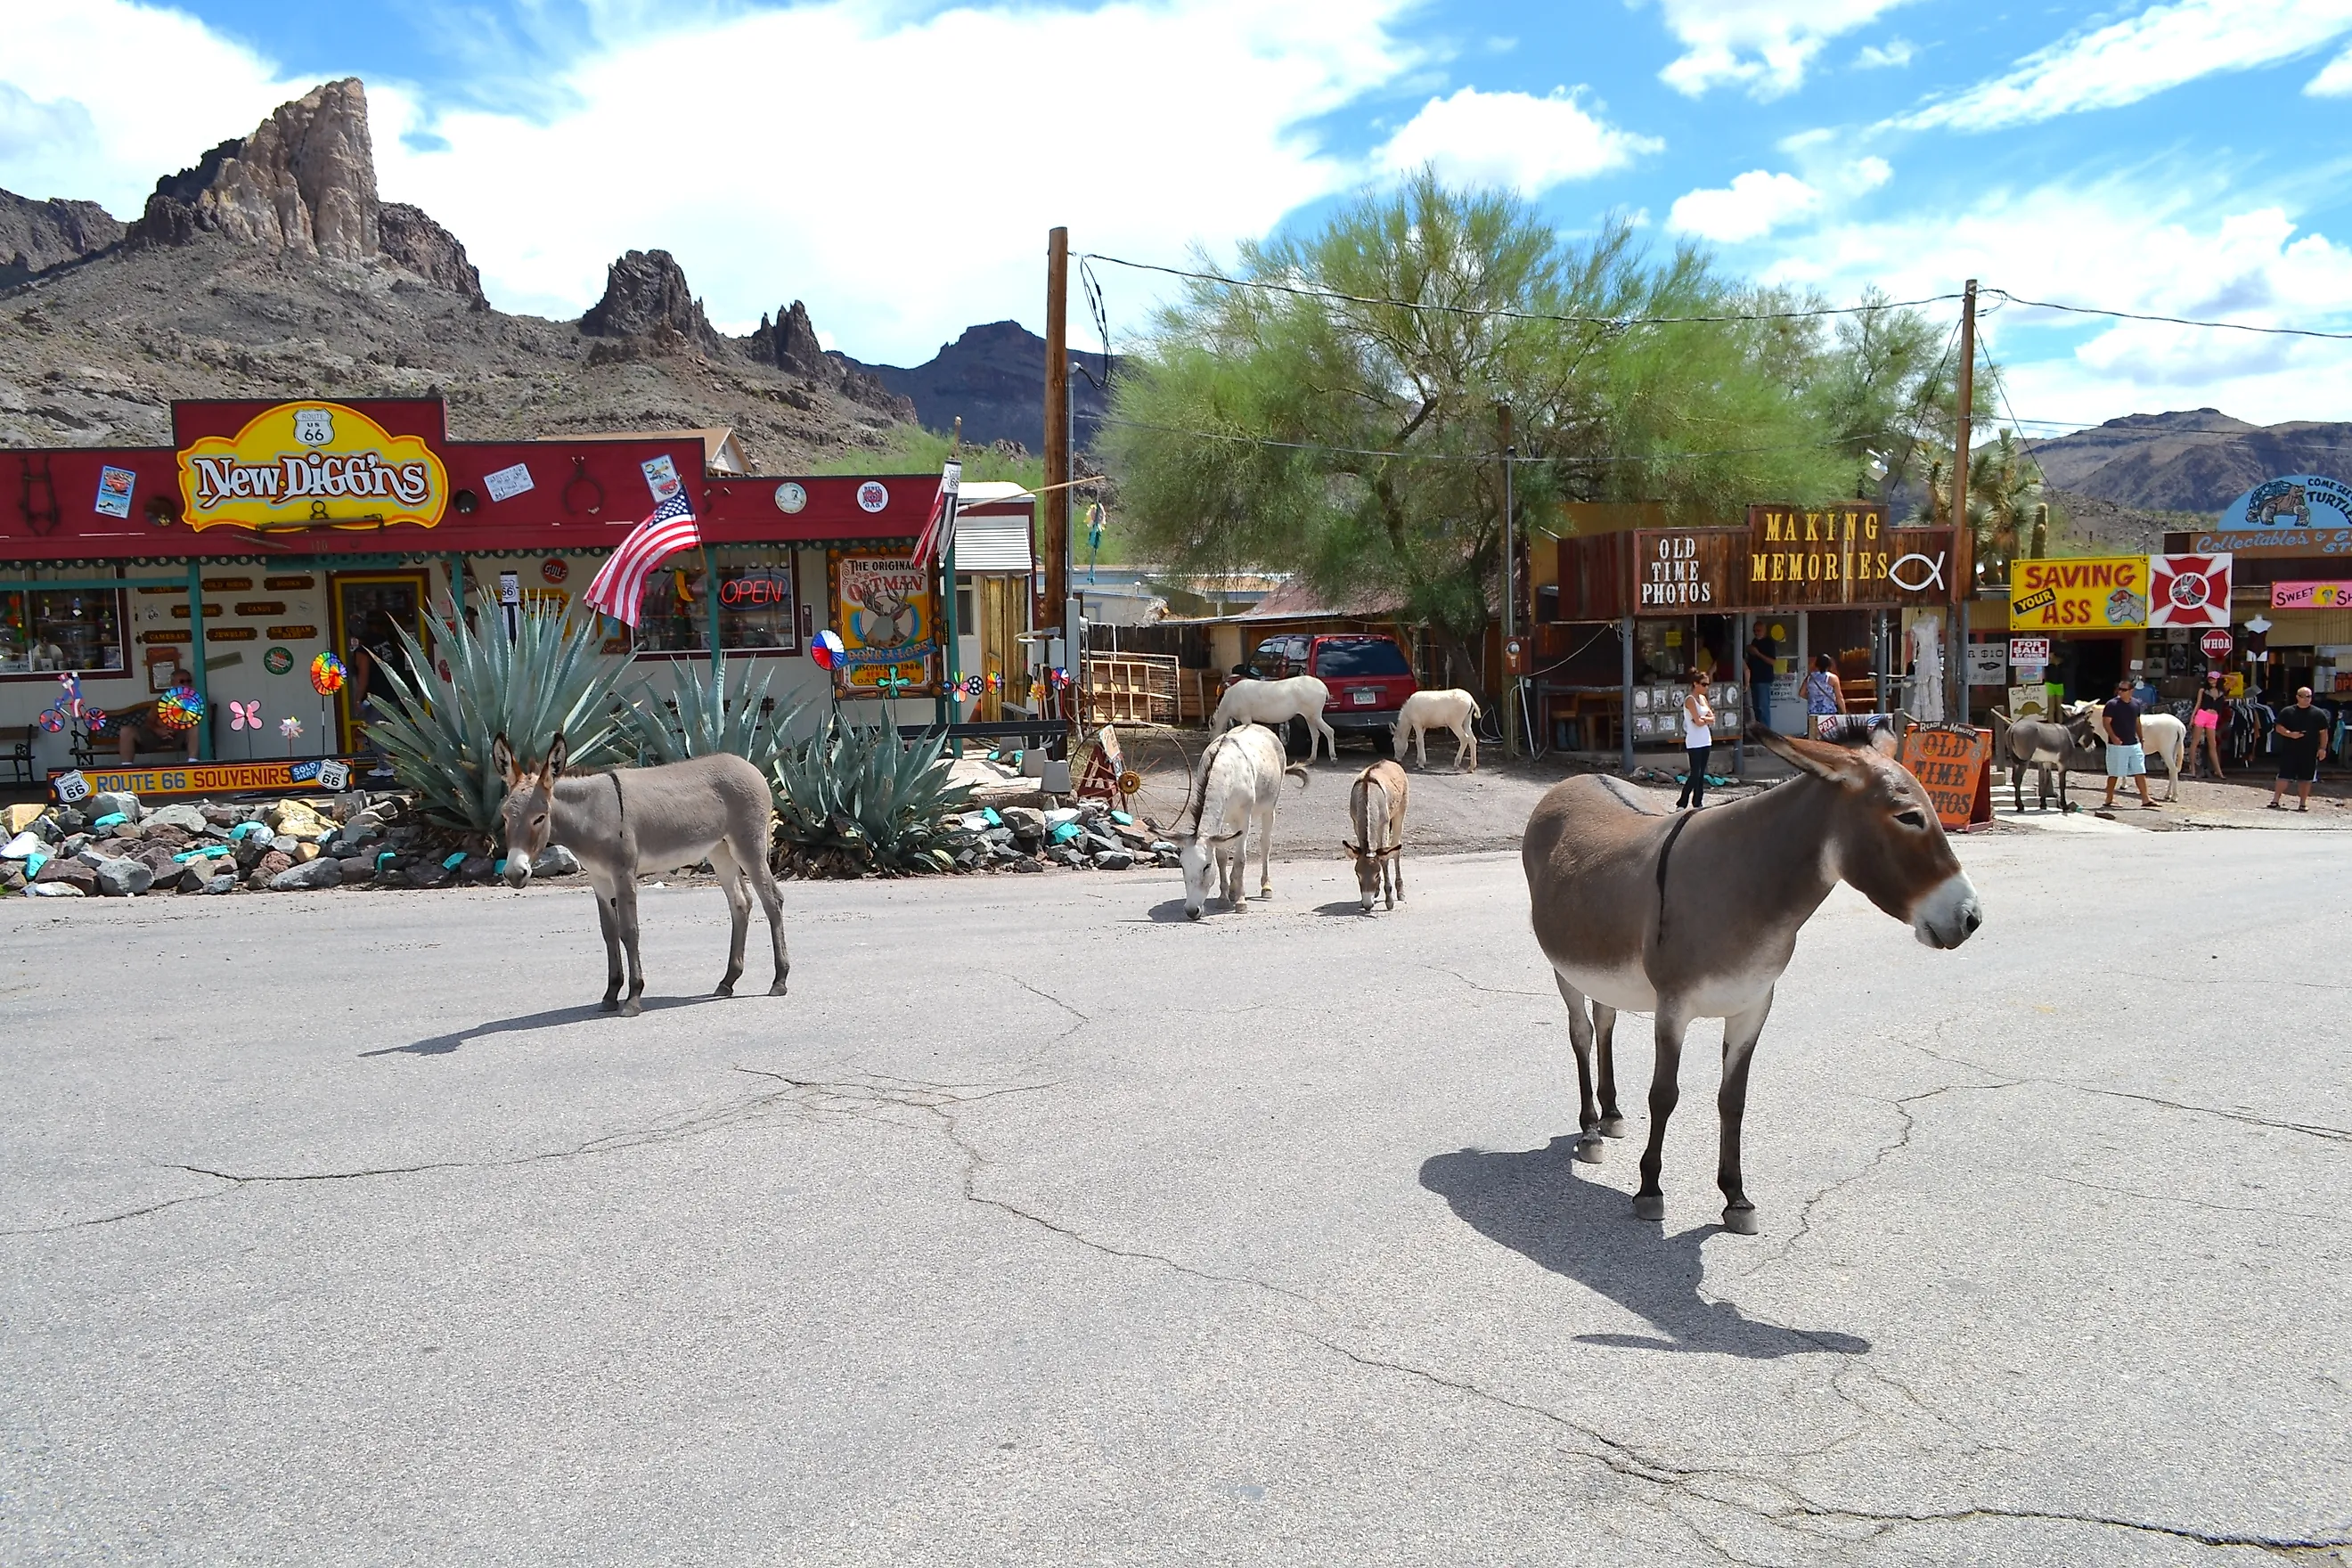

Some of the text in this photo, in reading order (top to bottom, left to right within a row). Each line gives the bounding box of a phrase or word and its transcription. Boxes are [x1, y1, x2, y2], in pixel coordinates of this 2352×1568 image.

[305, 429, 324, 441] 66
[193, 458, 282, 509] New
[2307, 478, 2337, 490] COME
[1765, 512, 1878, 542] MAKING
[1659, 537, 1696, 559] OLD
[2196, 530, 2309, 553] Collectables
[544, 565, 567, 579] GULF
[848, 559, 916, 575] THE ORIGINAL
[1652, 560, 1700, 582] TIME
[1752, 552, 1888, 582] MEMORIES
[2026, 564, 2137, 589] SAVING
[720, 580, 783, 604] OPEN
[847, 575, 924, 602] OATMAN
[1641, 582, 1711, 605] PHOTOS
[2018, 590, 2054, 611] YOUR
[148, 612, 159, 620] 66
[2042, 599, 2092, 625] ASS
[2202, 638, 2230, 649] WHOA
[1817, 715, 1837, 733] PRAY
[1919, 721, 1940, 732] READY
[1948, 723, 1977, 737] MINUTES
[1923, 734, 1968, 758] OLD
[293, 762, 316, 775] SOLD
[324, 770, 341, 778] ROUTE
[1914, 760, 1968, 787] TIME
[63, 780, 81, 790] ROUTE
[95, 767, 291, 792] ROUTE 66 SOUVENIRS
[323, 773, 340, 787] 66
[66, 784, 86, 798] 66
